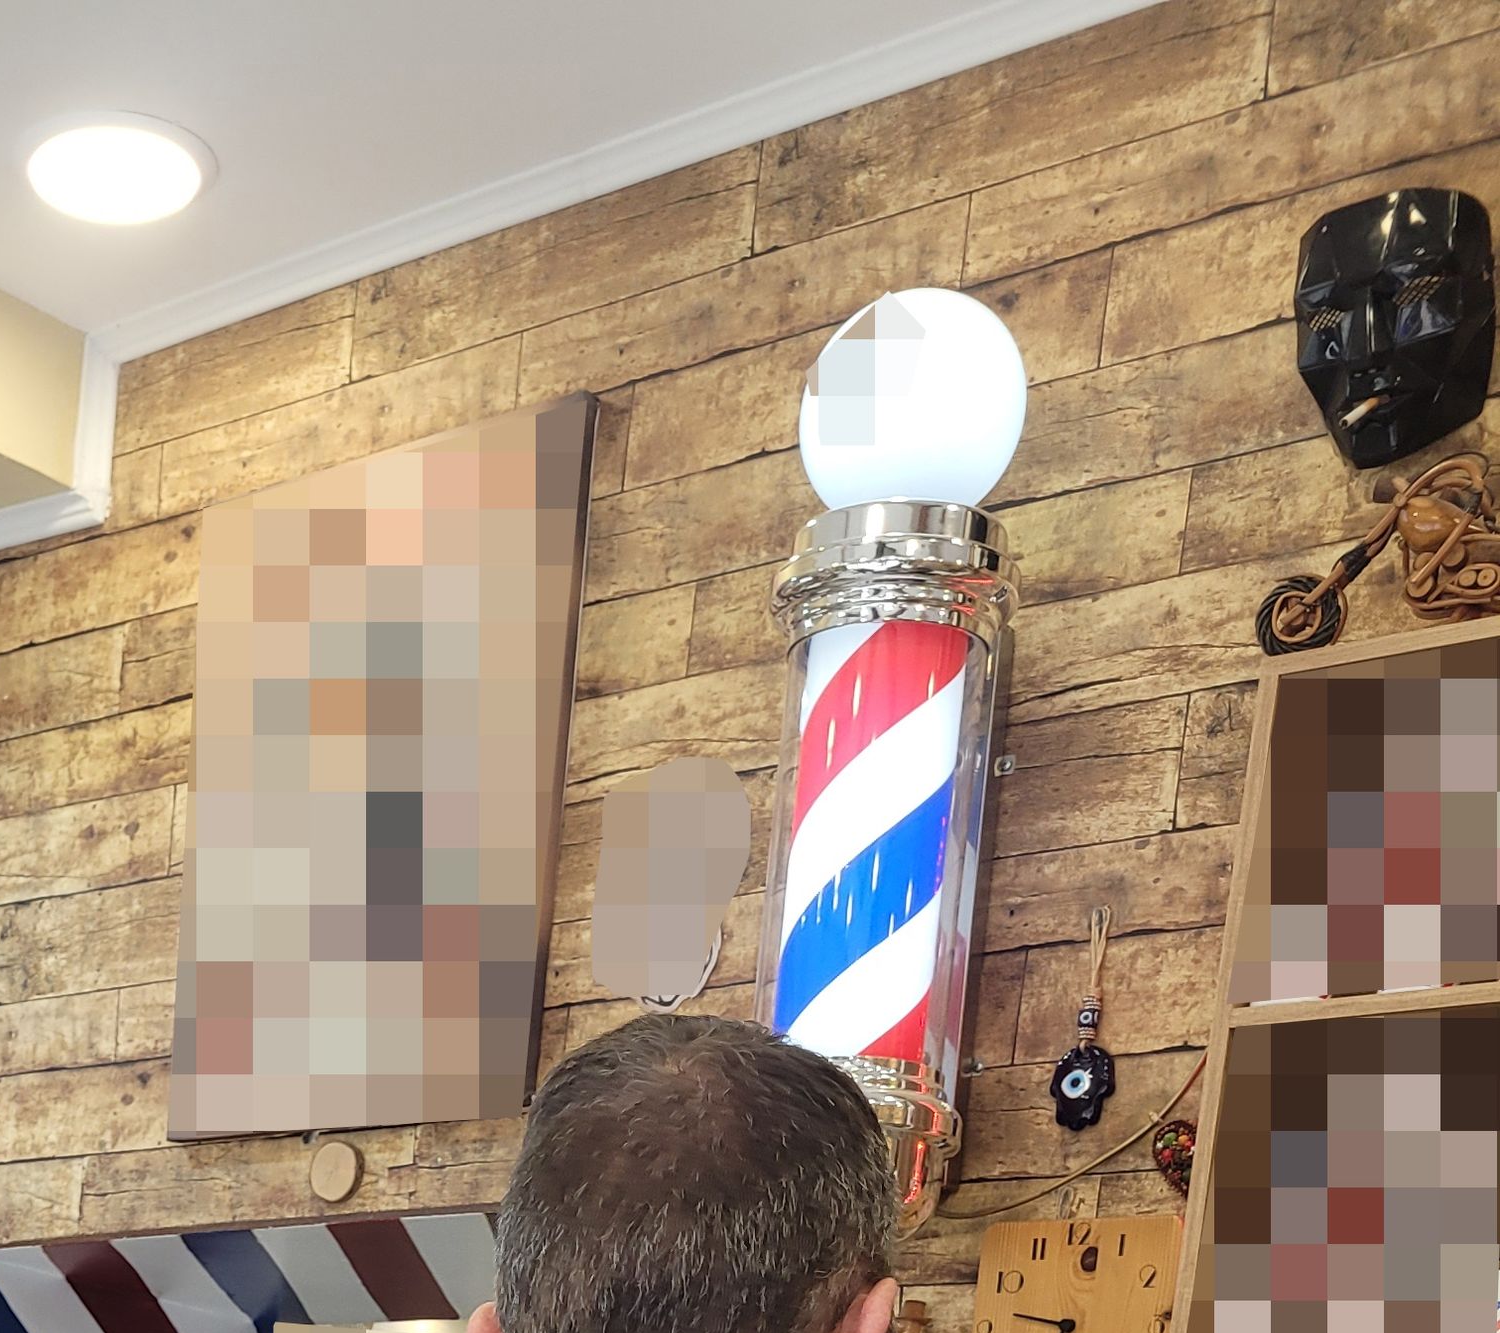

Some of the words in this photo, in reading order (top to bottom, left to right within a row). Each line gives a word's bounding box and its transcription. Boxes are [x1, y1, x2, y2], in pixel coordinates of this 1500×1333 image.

[1067, 1222, 1091, 1246] 12
[1118, 1234, 1126, 1256] 1
[1032, 1238, 1047, 1260] 11
[997, 1271, 1024, 1293] 10
[1139, 1264, 1157, 1288] 2
